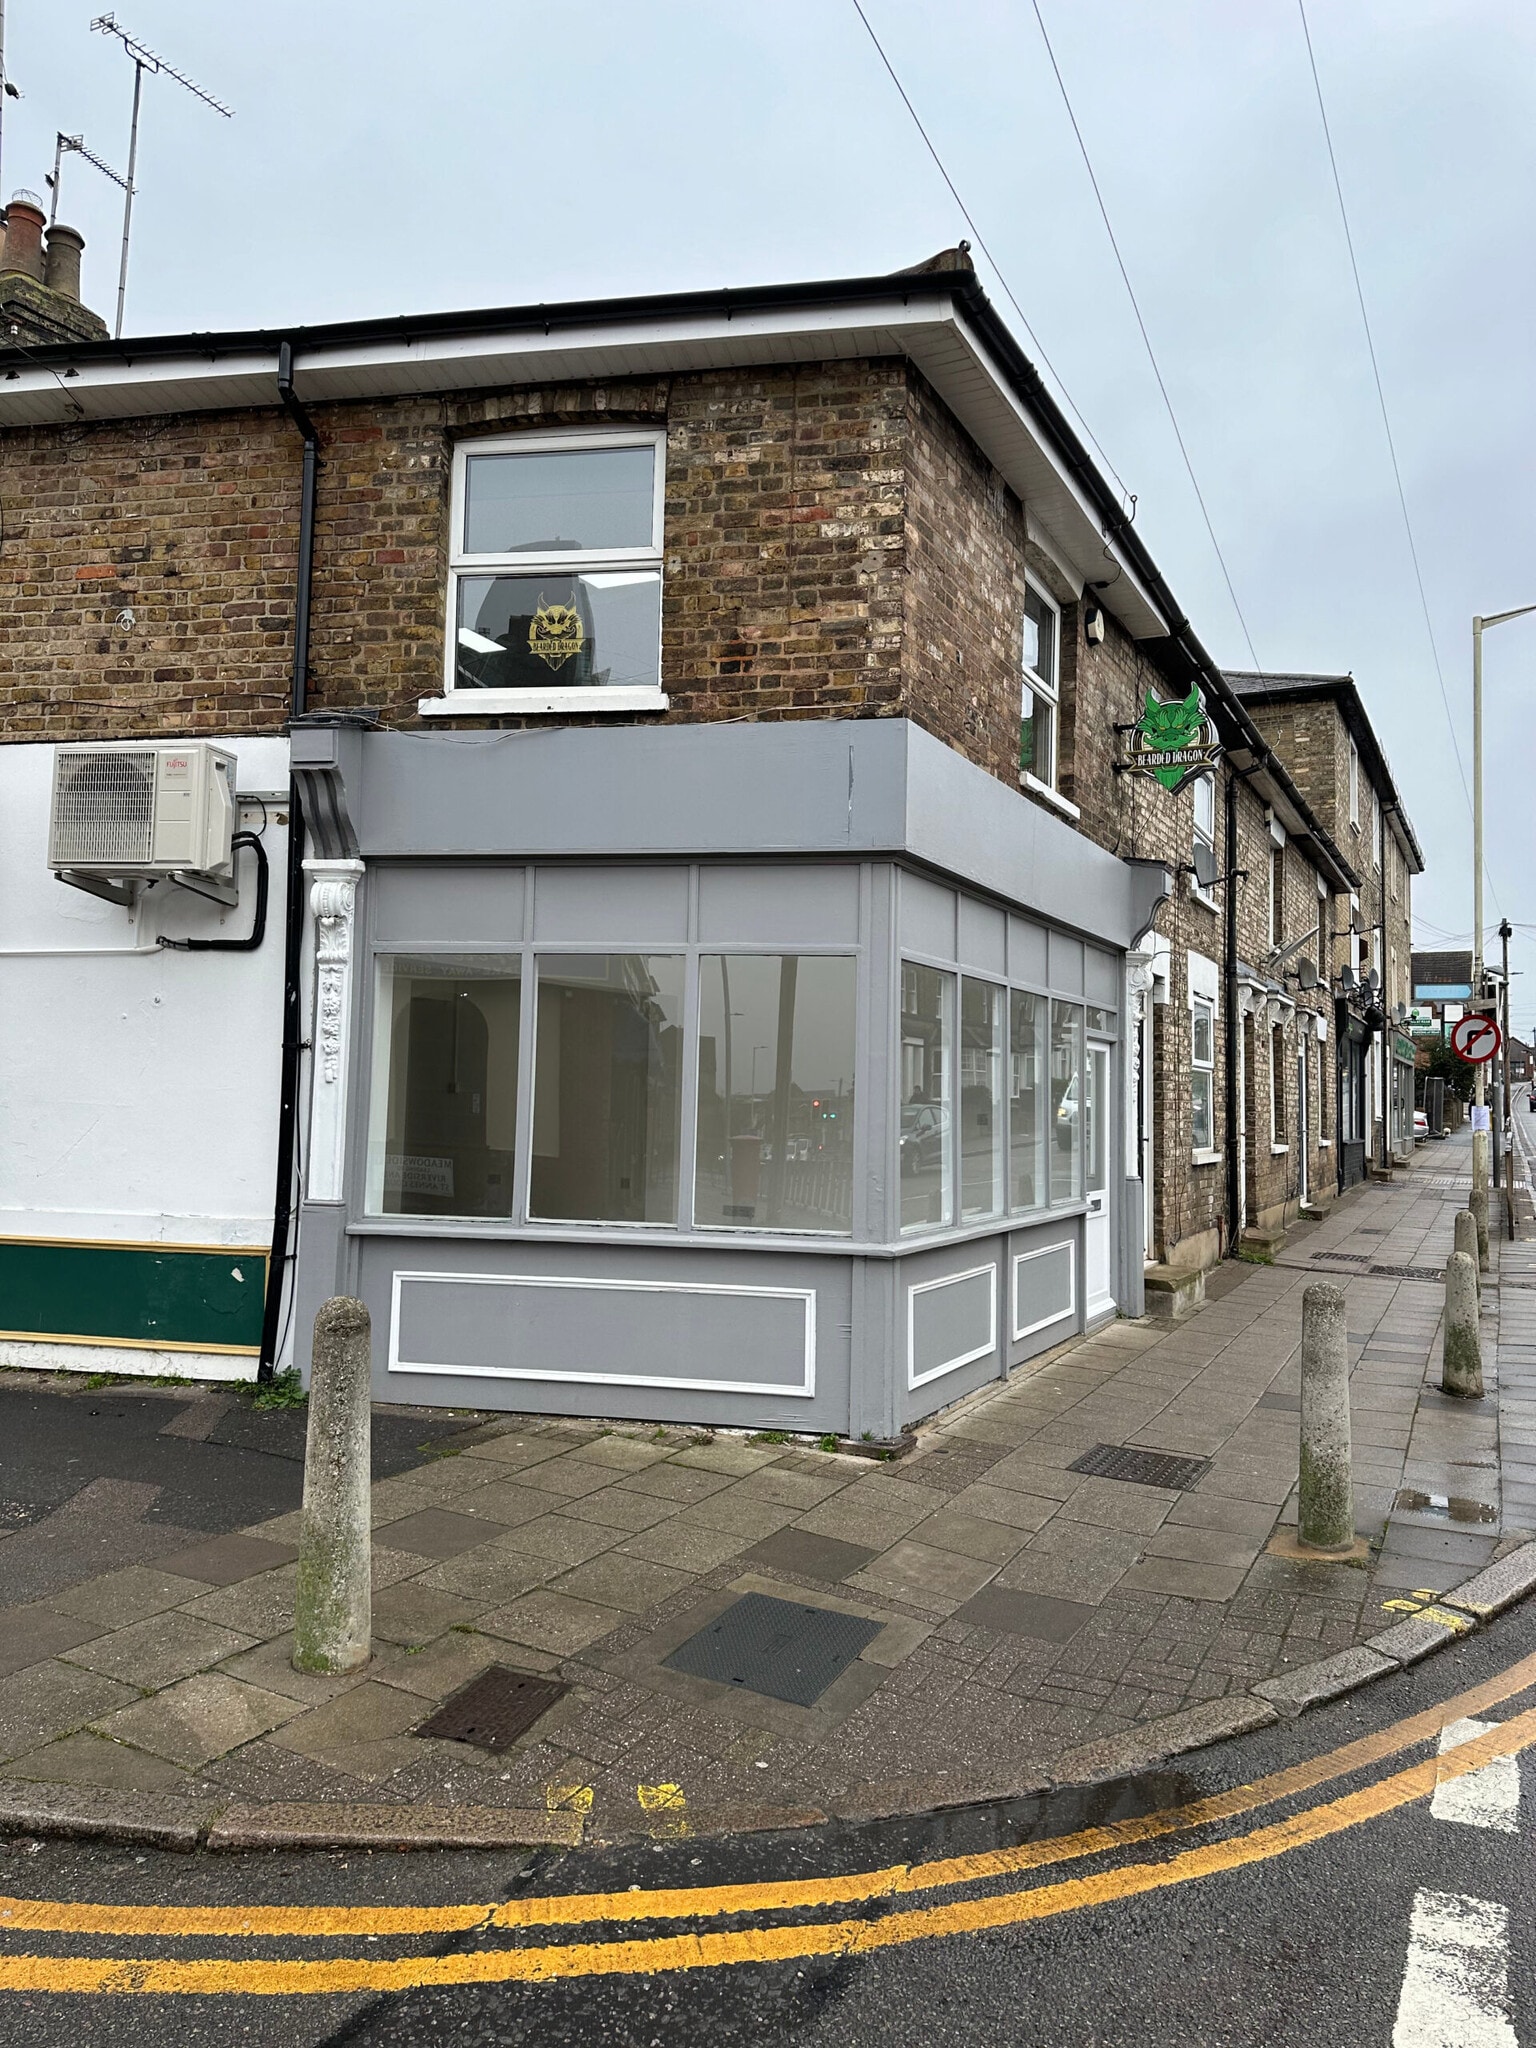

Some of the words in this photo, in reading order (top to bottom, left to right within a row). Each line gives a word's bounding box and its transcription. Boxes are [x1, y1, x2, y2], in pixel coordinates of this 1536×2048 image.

[533, 641, 556, 651] BEARDED
[558, 641, 579, 650] DRAGON
[1137, 751, 1171, 766] BEARDED
[1172, 749, 1204, 763] DRAGON
[166, 760, 188, 769] FUJITSU
